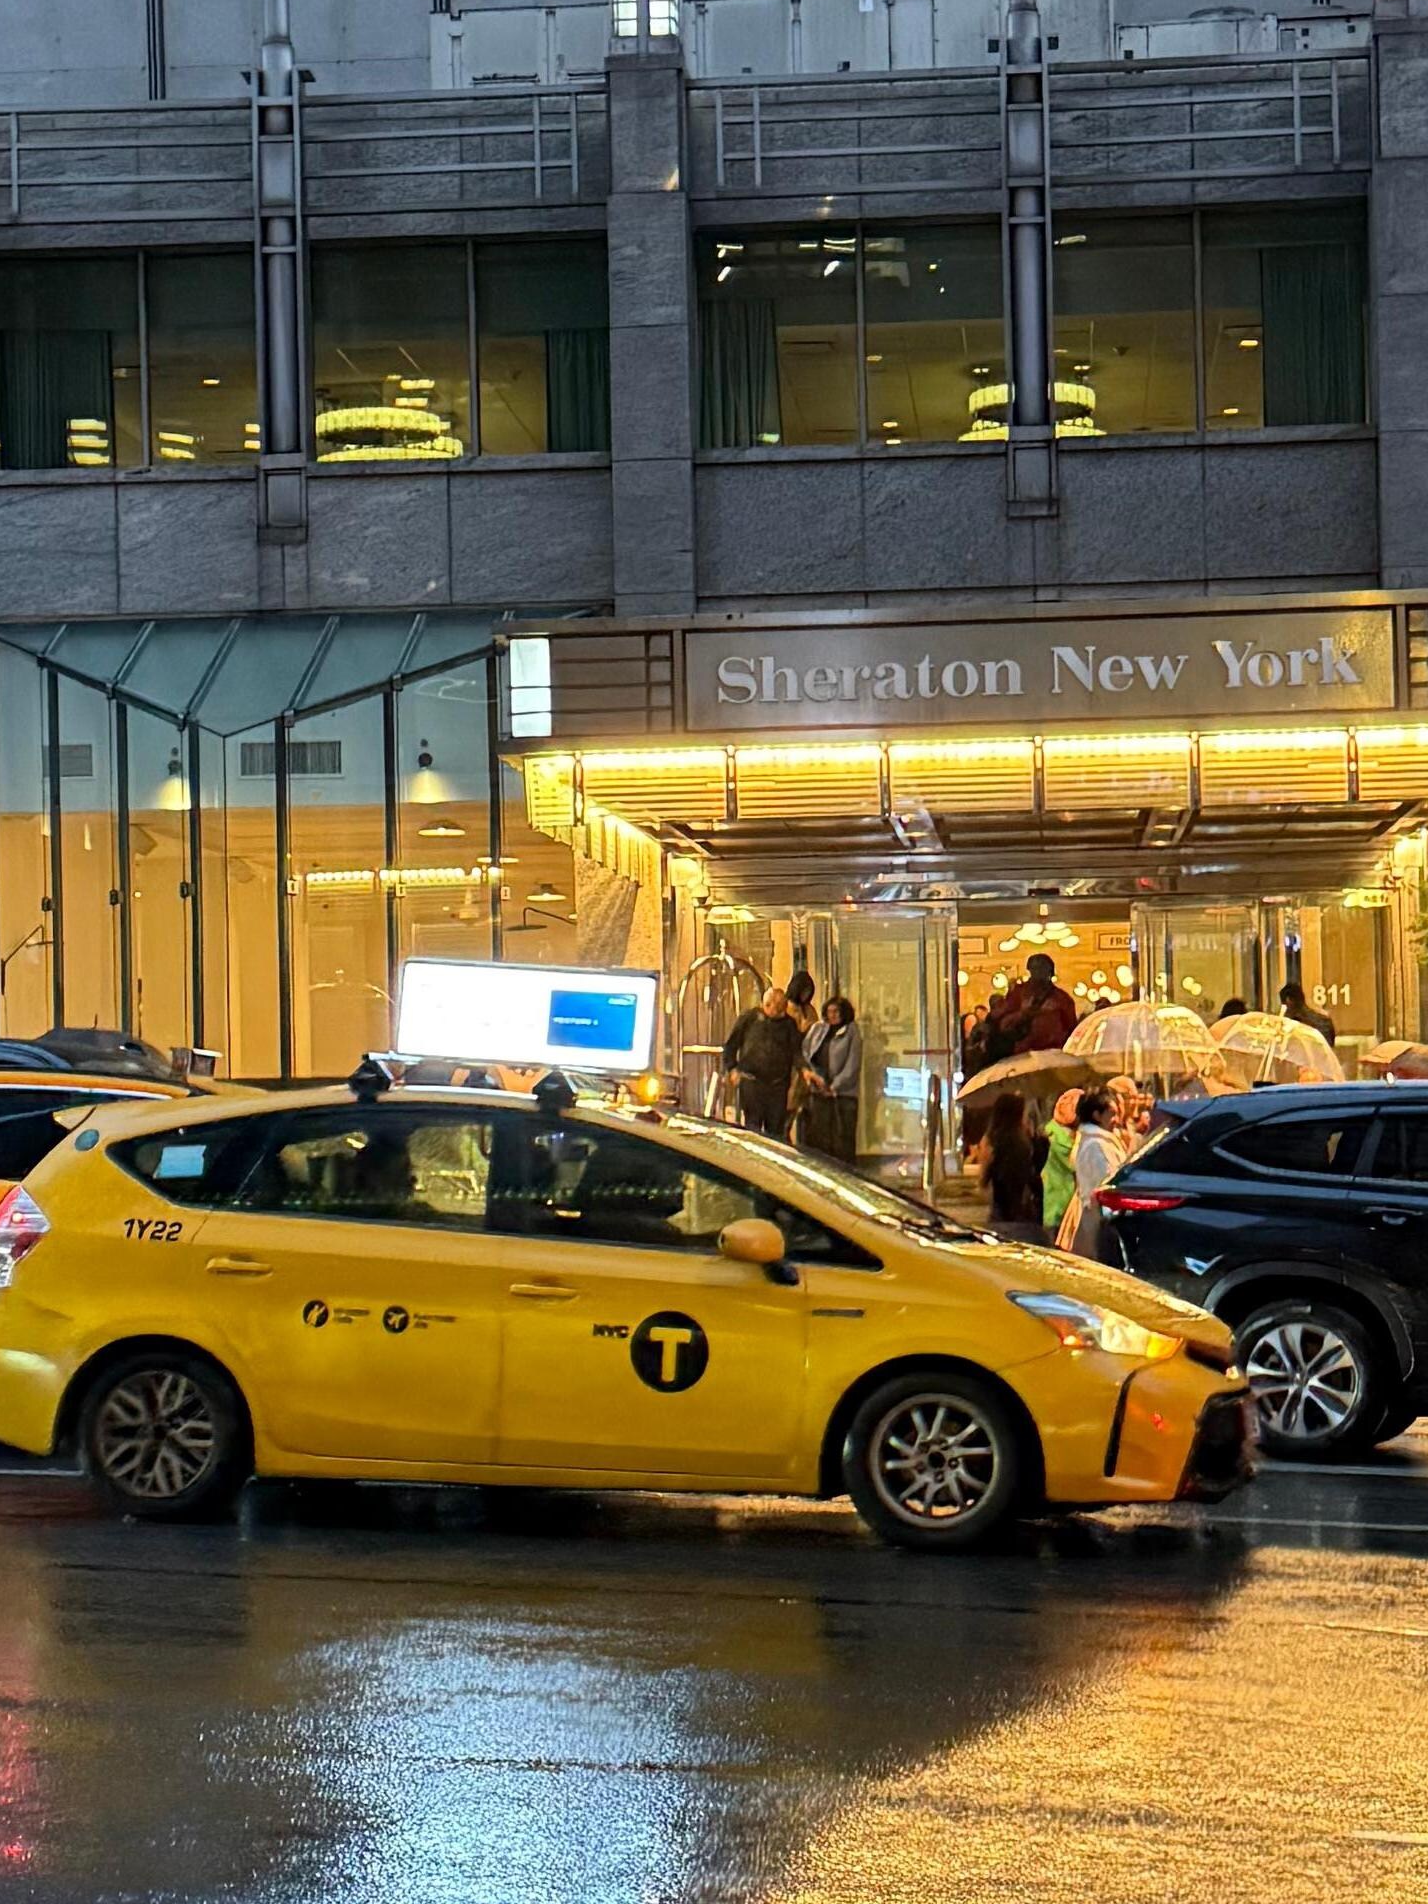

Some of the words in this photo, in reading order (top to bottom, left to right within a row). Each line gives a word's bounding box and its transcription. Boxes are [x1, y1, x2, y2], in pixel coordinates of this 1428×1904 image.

[717, 653, 1023, 703] Sheraton
[1051, 646, 1188, 693] New
[1211, 637, 1361, 687] York
[1312, 983, 1351, 1006] 811
[124, 1218, 183, 1242] 1Y22
[593, 1324, 629, 1338] NYC
[650, 1327, 691, 1382] T
